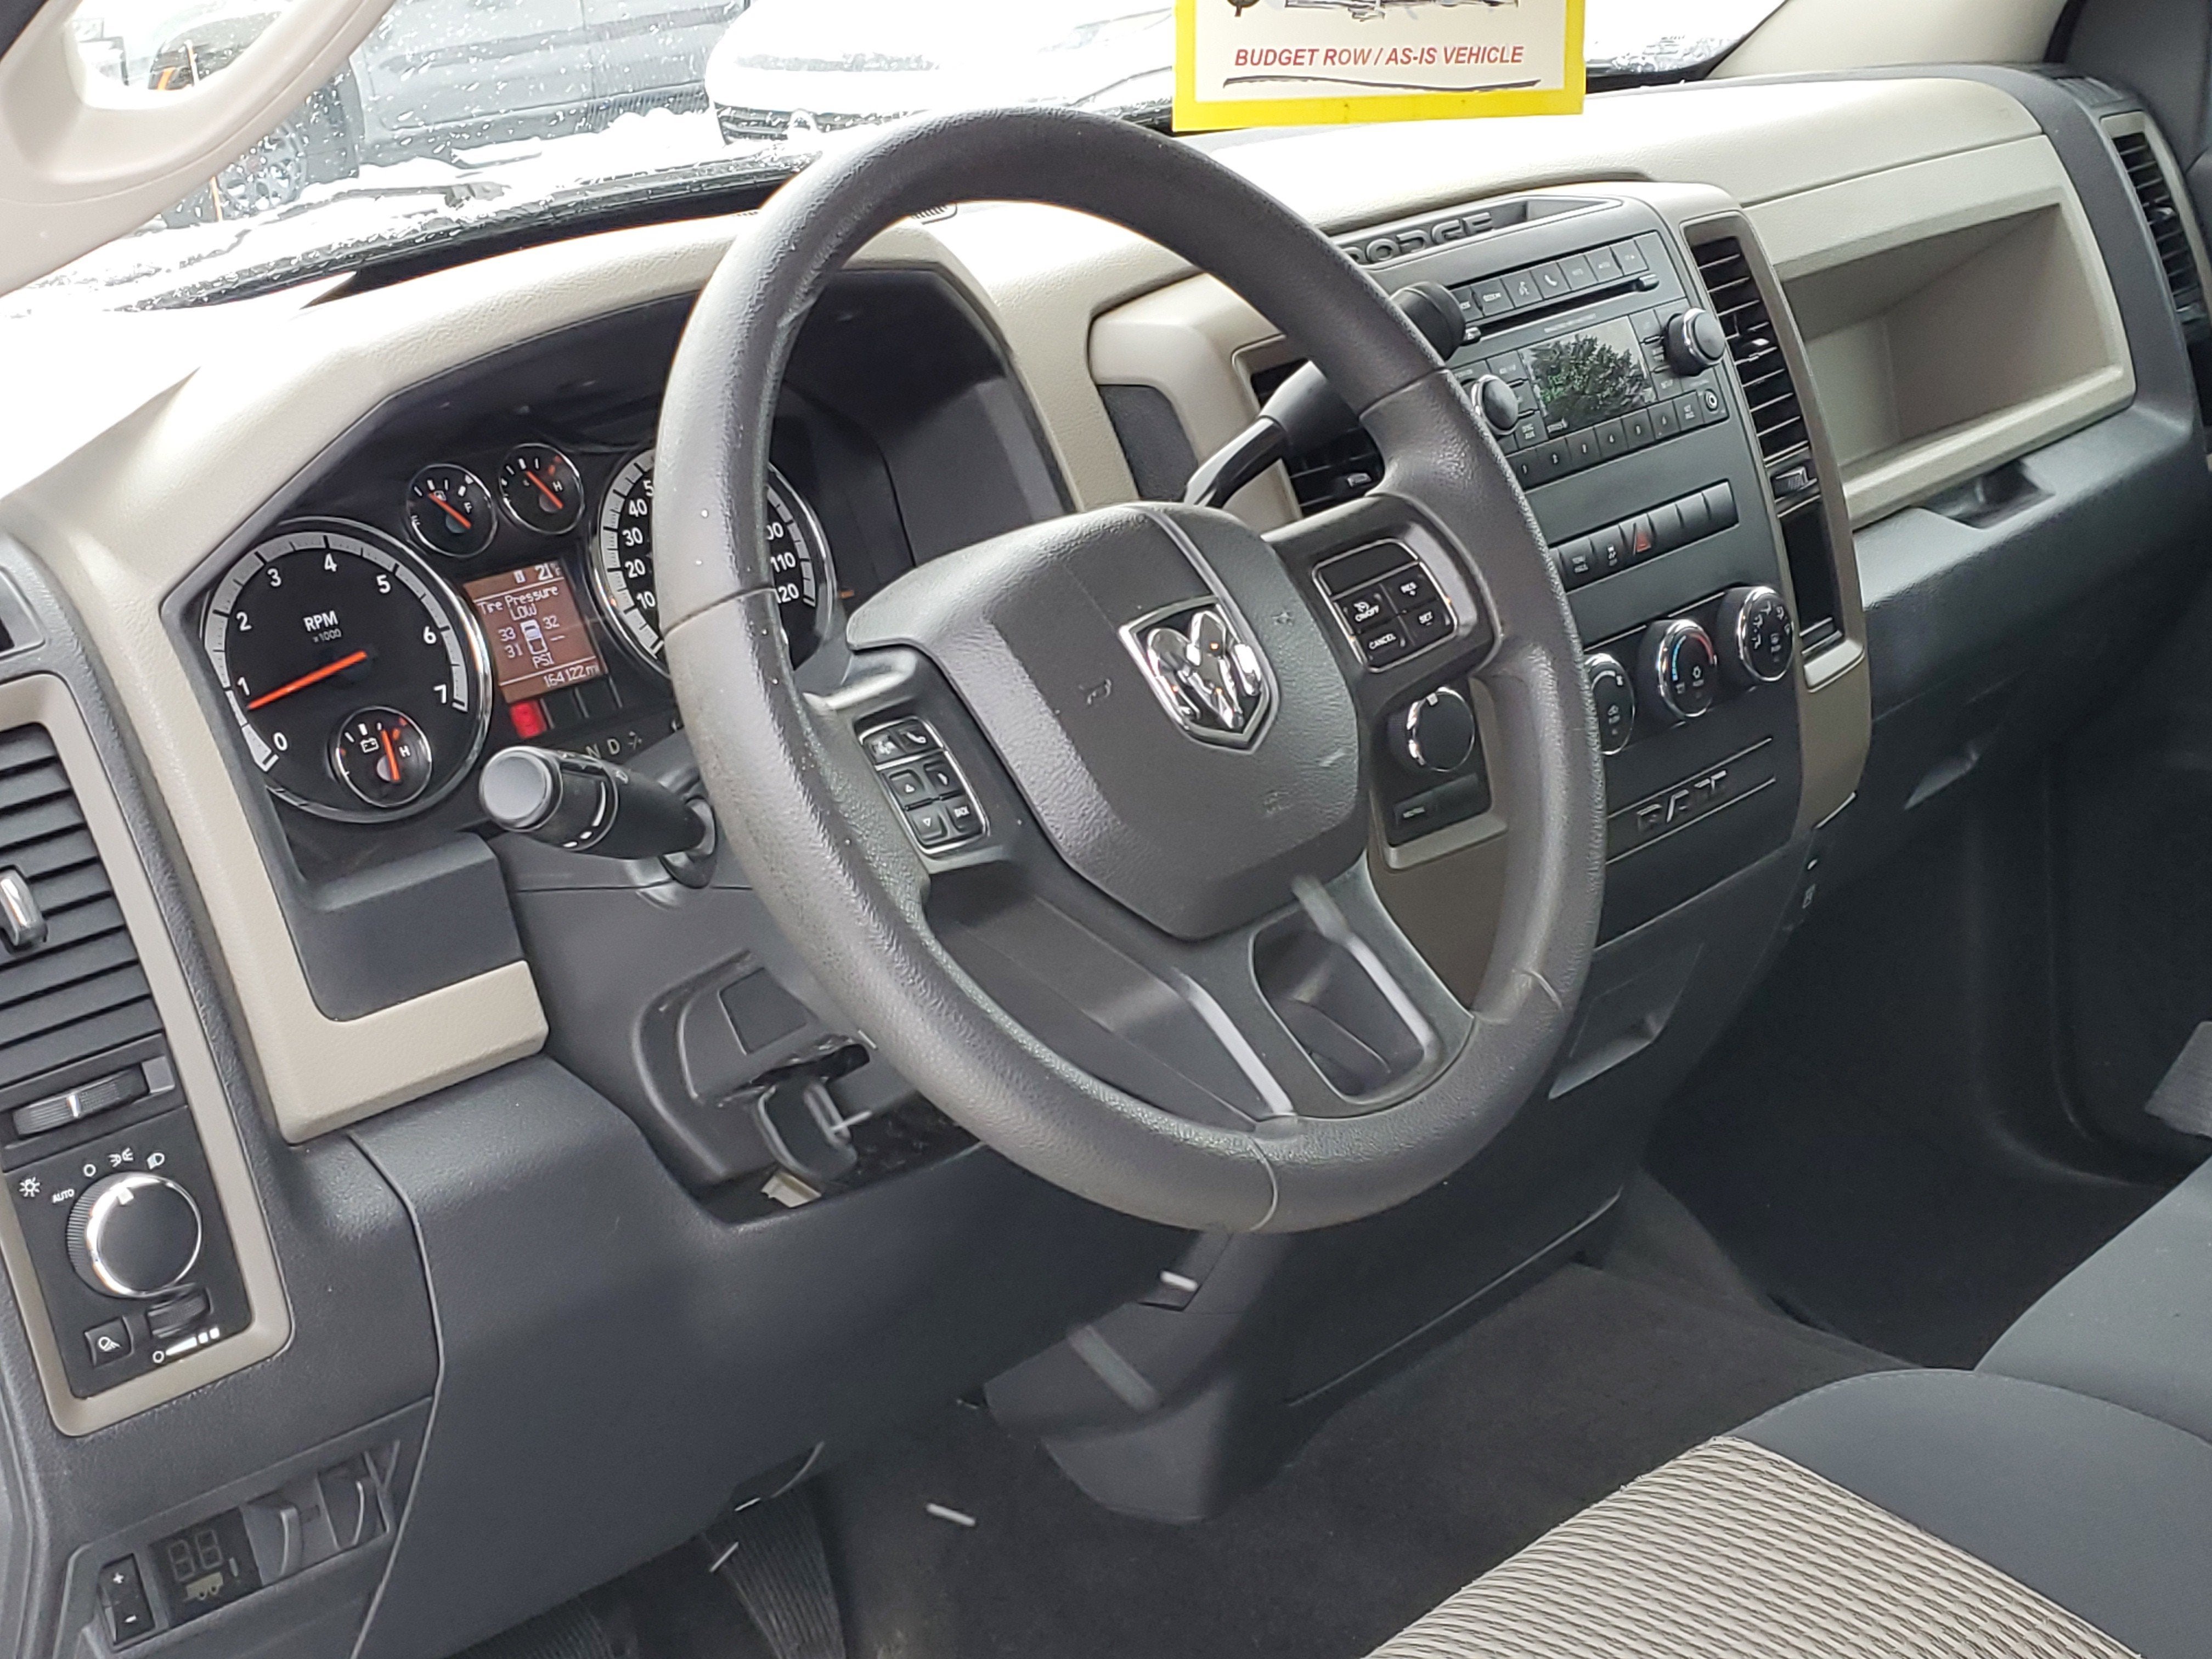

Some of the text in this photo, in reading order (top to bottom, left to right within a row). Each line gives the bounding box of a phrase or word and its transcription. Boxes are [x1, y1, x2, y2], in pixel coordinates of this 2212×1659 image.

[1235, 48, 1319, 66] BUDGET
[1323, 47, 1373, 66] ROW
[1385, 47, 1438, 65] AS-IS
[1443, 46, 1523, 64] VEHICLE
[629, 499, 648, 517] 40
[622, 527, 644, 546] 30
[766, 522, 784, 540] 00
[324, 553, 337, 572] 4
[624, 558, 646, 578] 20
[770, 552, 796, 573] 110
[267, 568, 282, 587] 3
[376, 575, 391, 594] 5
[477, 586, 559, 614] Tire Pressure
[636, 591, 656, 610] 10
[236, 612, 251, 630] 2
[303, 610, 338, 631] RPM
[510, 604, 537, 620] LOW
[543, 616, 560, 629] 32
[422, 626, 437, 644] 6
[498, 627, 516, 641] 33
[505, 644, 523, 658] 31
[532, 651, 555, 669] PSI
[237, 676, 250, 695] 1
[434, 684, 447, 704] 7
[274, 732, 288, 751] 0
[607, 738, 620, 755] D
[52, 1188, 75, 1204] AUTO
